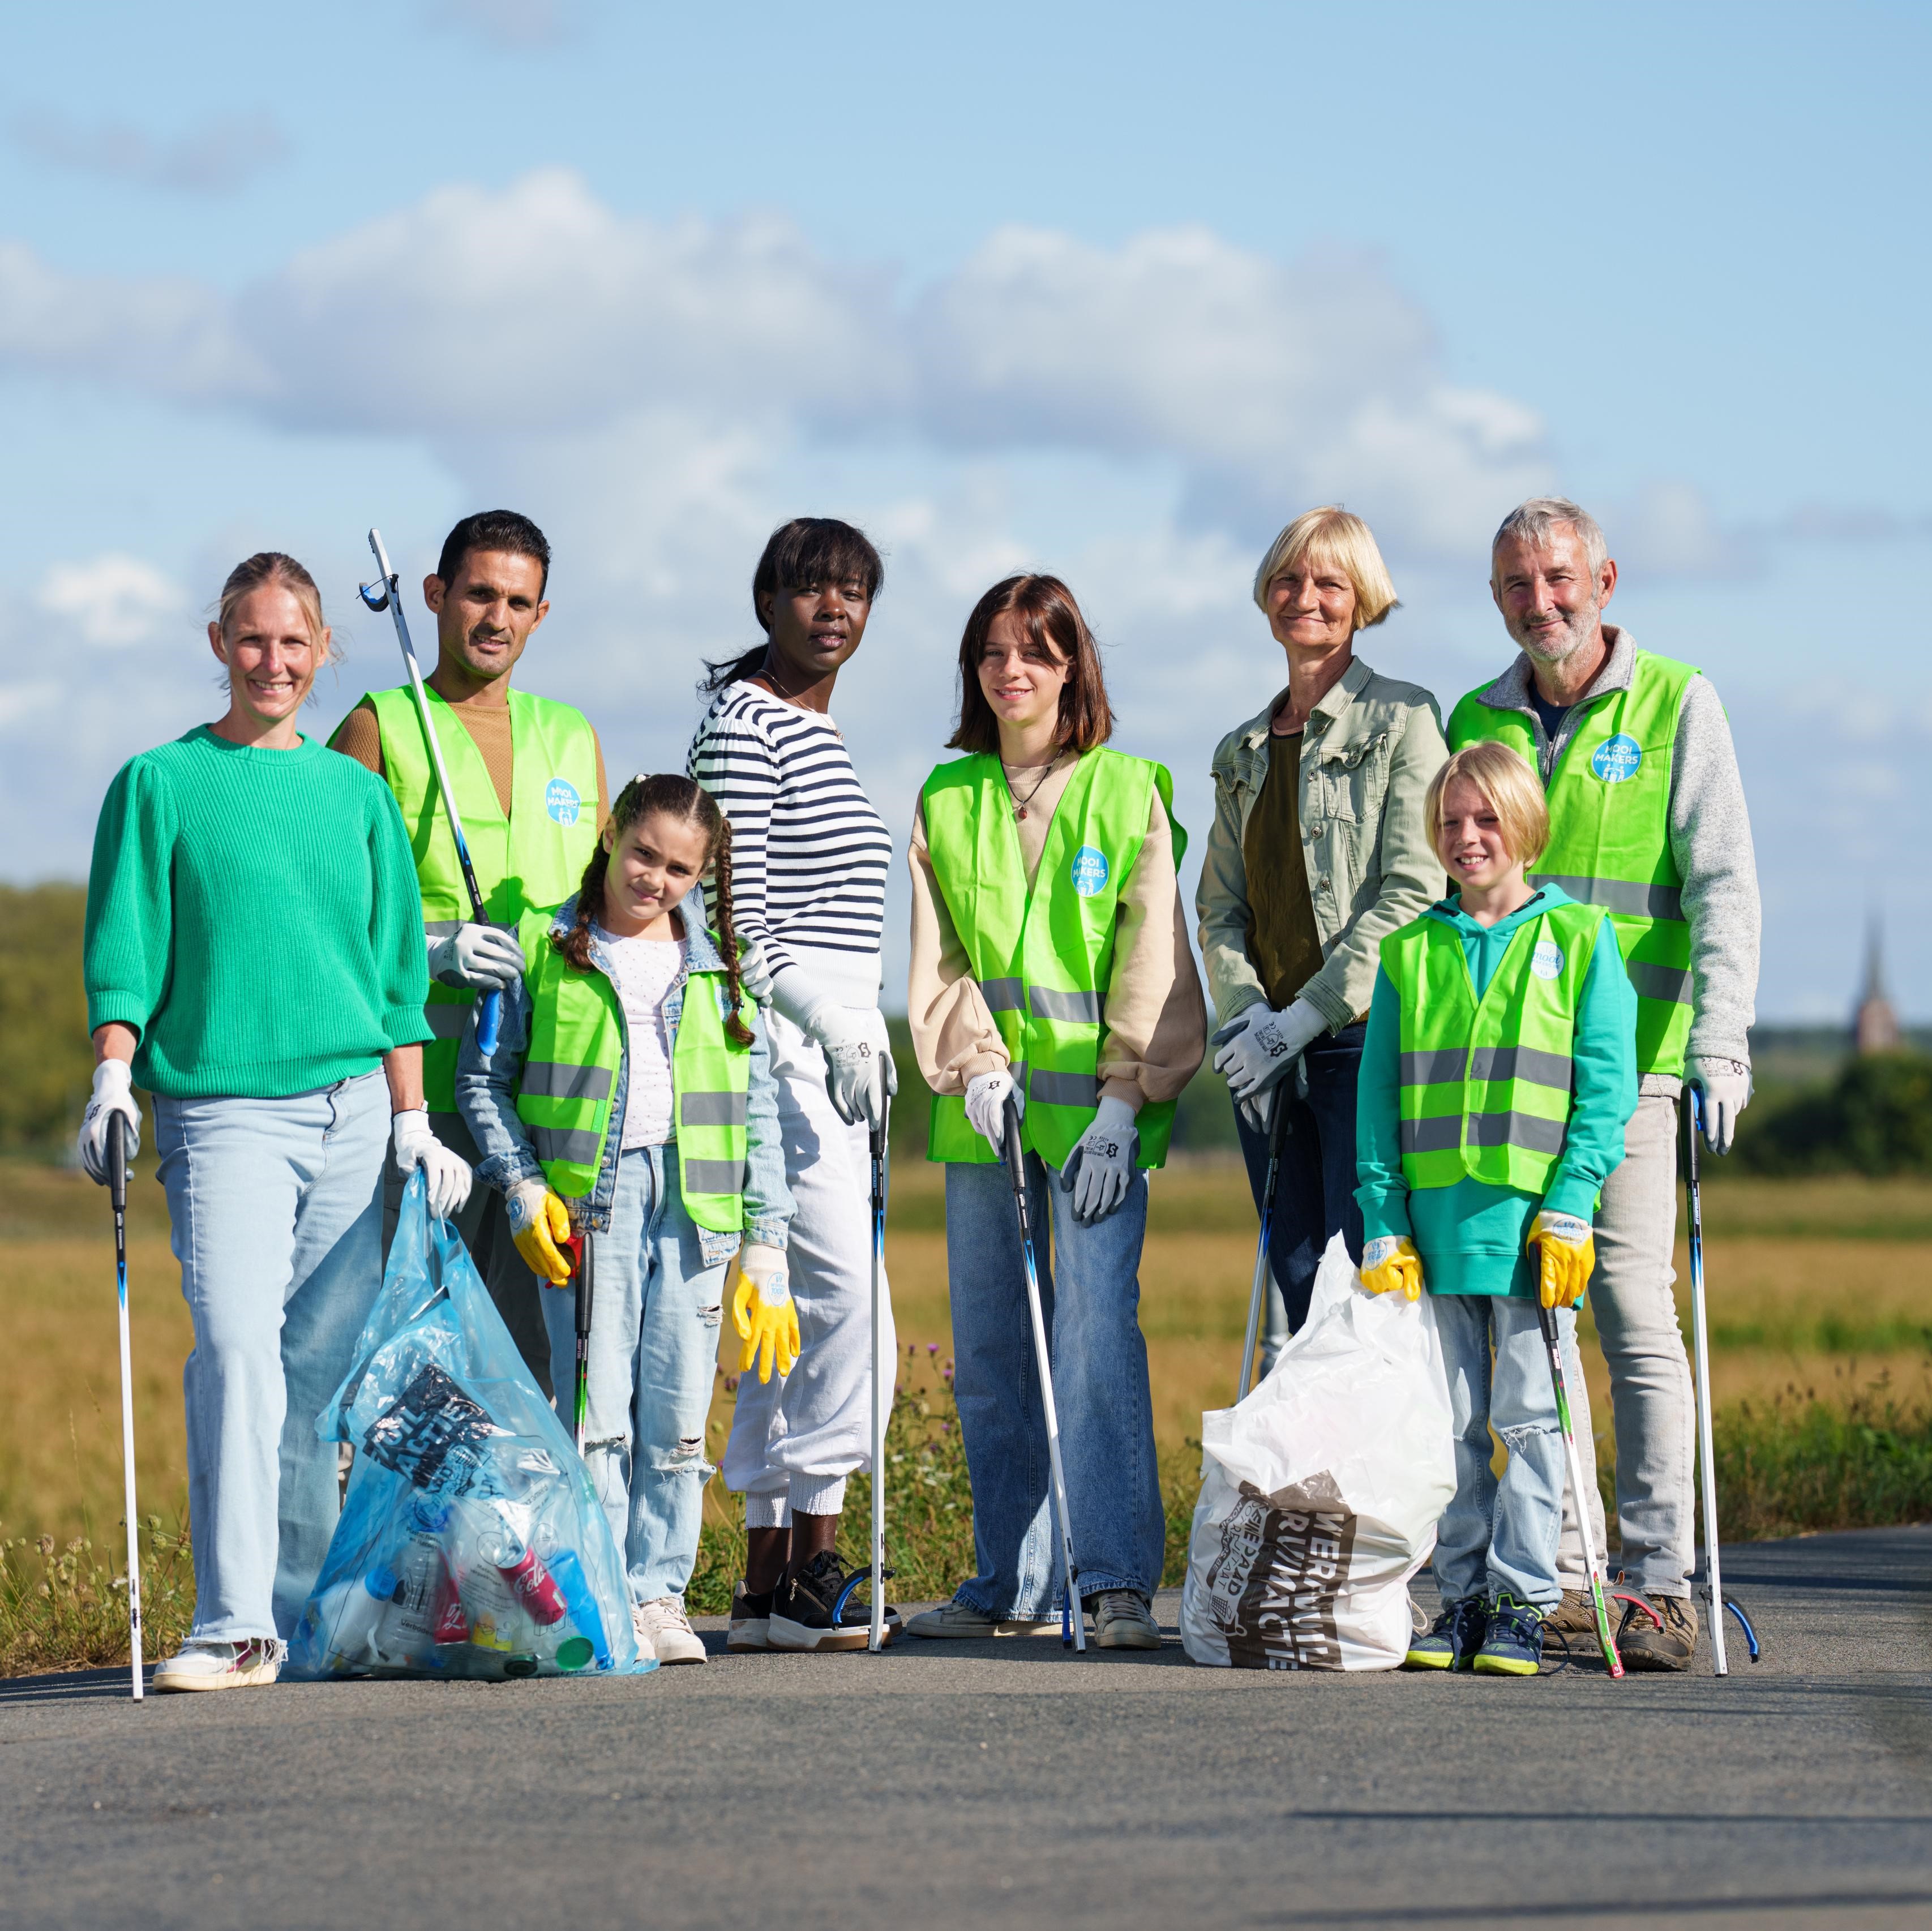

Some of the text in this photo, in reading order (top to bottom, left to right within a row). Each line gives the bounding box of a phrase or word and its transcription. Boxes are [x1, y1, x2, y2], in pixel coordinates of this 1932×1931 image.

[1605, 744, 1633, 754] MOOI
[1595, 753, 1638, 765] MAKERS
[551, 786, 571, 799] MOOI
[547, 796, 579, 808] MAKERS
[1077, 856, 1099, 868] MOOI
[1073, 866, 1106, 878] MAKERS
[401, 1619, 435, 1637] Verboden
